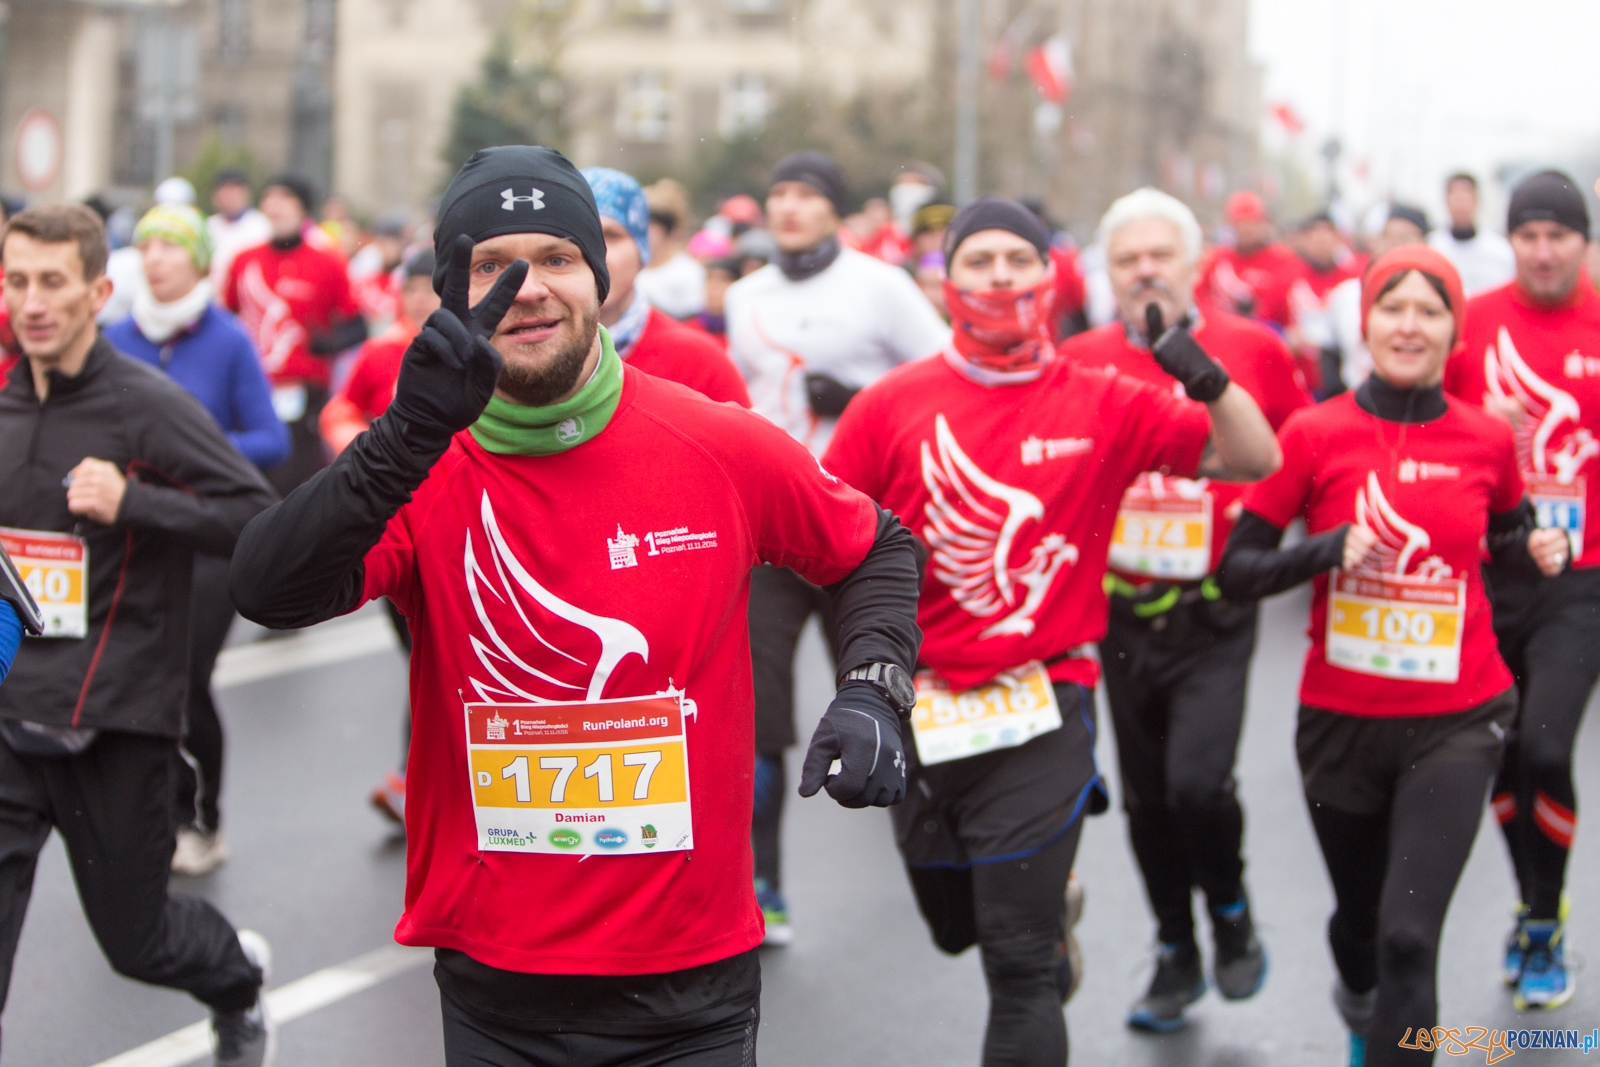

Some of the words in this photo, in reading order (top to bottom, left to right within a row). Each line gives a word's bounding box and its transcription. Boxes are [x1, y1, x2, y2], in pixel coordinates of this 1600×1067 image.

[643, 532, 660, 556] 1
[1360, 607, 1435, 644] 100
[512, 719, 523, 736] 1
[582, 716, 668, 731] RunPoland.org
[476, 771, 492, 787] D
[501, 750, 663, 803] 1717
[555, 812, 606, 823] Damian
[487, 828, 519, 838] GRUPA
[488, 836, 526, 846] LUXMED
